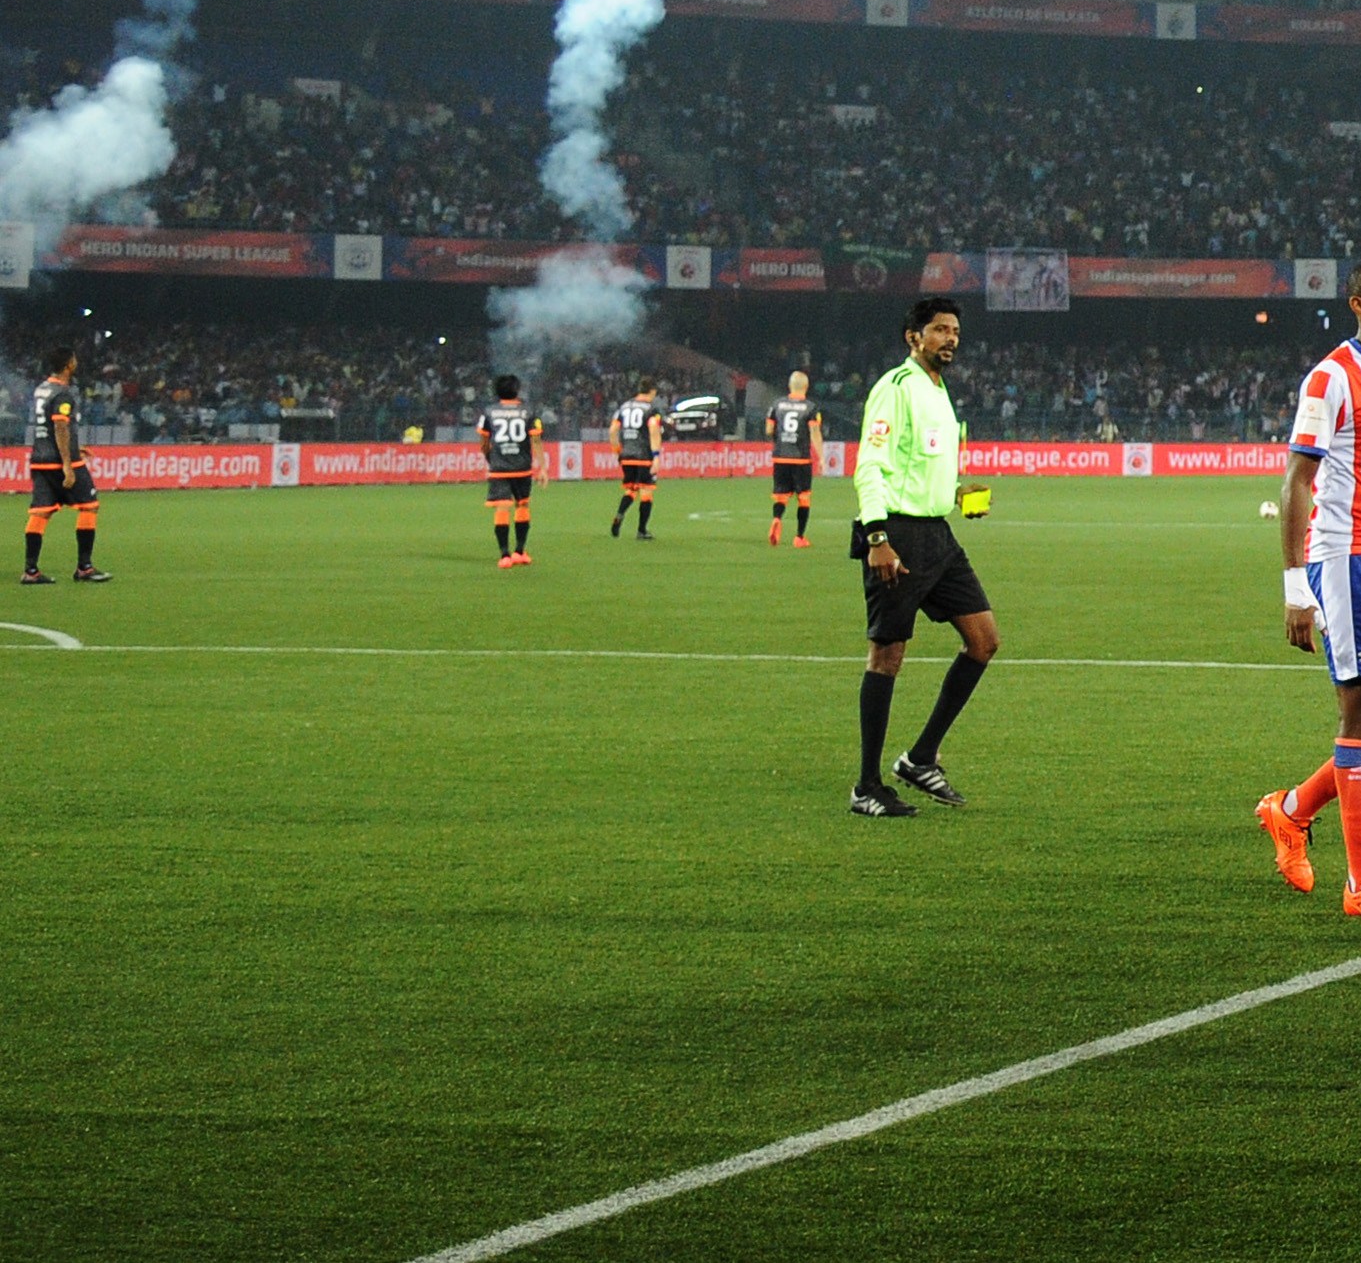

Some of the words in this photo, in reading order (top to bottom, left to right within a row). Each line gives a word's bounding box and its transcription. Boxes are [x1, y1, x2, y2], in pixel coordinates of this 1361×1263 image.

[81, 241, 123, 256] HERO
[126, 243, 179, 258] INDIAN
[184, 245, 231, 260] SUPER
[234, 246, 291, 262] LEAGUE
[749, 262, 788, 275] HERO
[791, 264, 823, 277] INDI
[620, 408, 643, 429] 10
[783, 411, 799, 433] 6
[493, 418, 526, 443] 20
